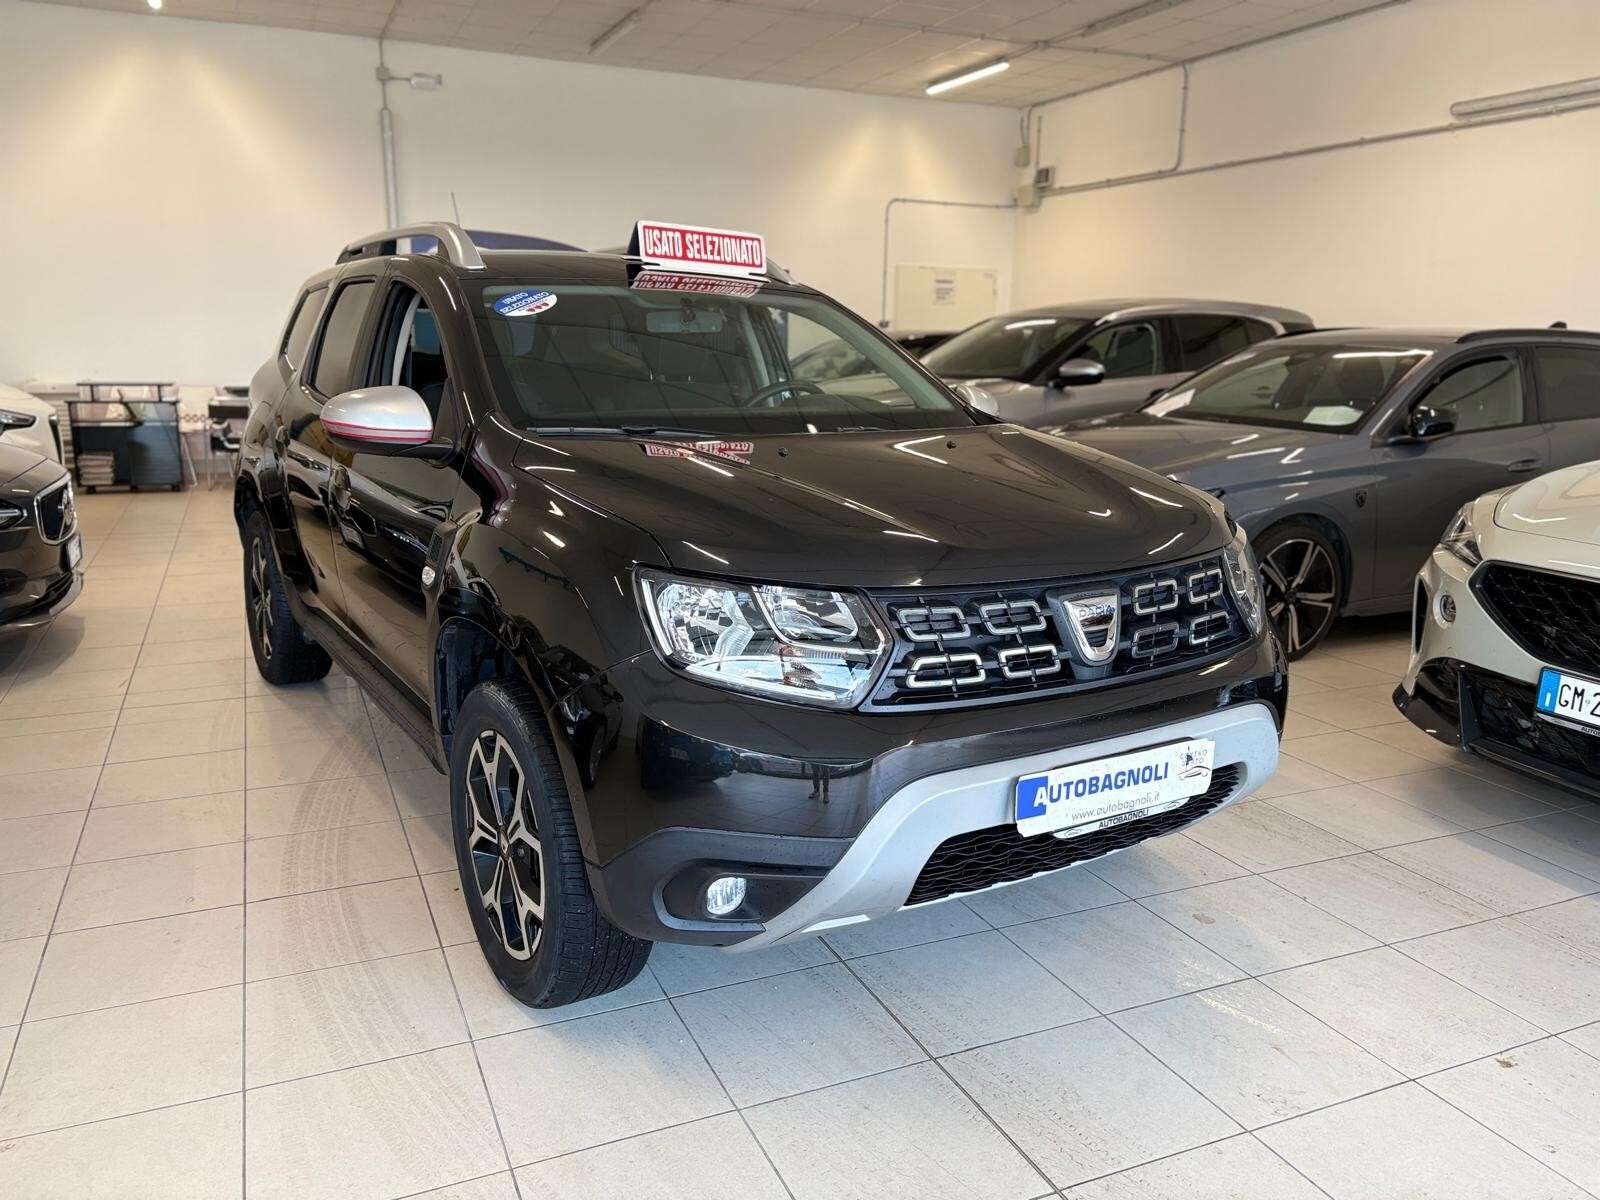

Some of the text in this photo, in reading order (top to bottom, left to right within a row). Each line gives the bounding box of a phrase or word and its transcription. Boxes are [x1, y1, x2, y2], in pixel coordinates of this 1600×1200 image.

[644, 228, 761, 266] USATO SELEZIONATO
[1079, 604, 1116, 618] DACIA
[1034, 762, 1168, 807] AUTOBAGNOLI
[1071, 791, 1160, 820] www.autobagnoli.it
[1098, 809, 1149, 828] AUTOBAGNOLI
